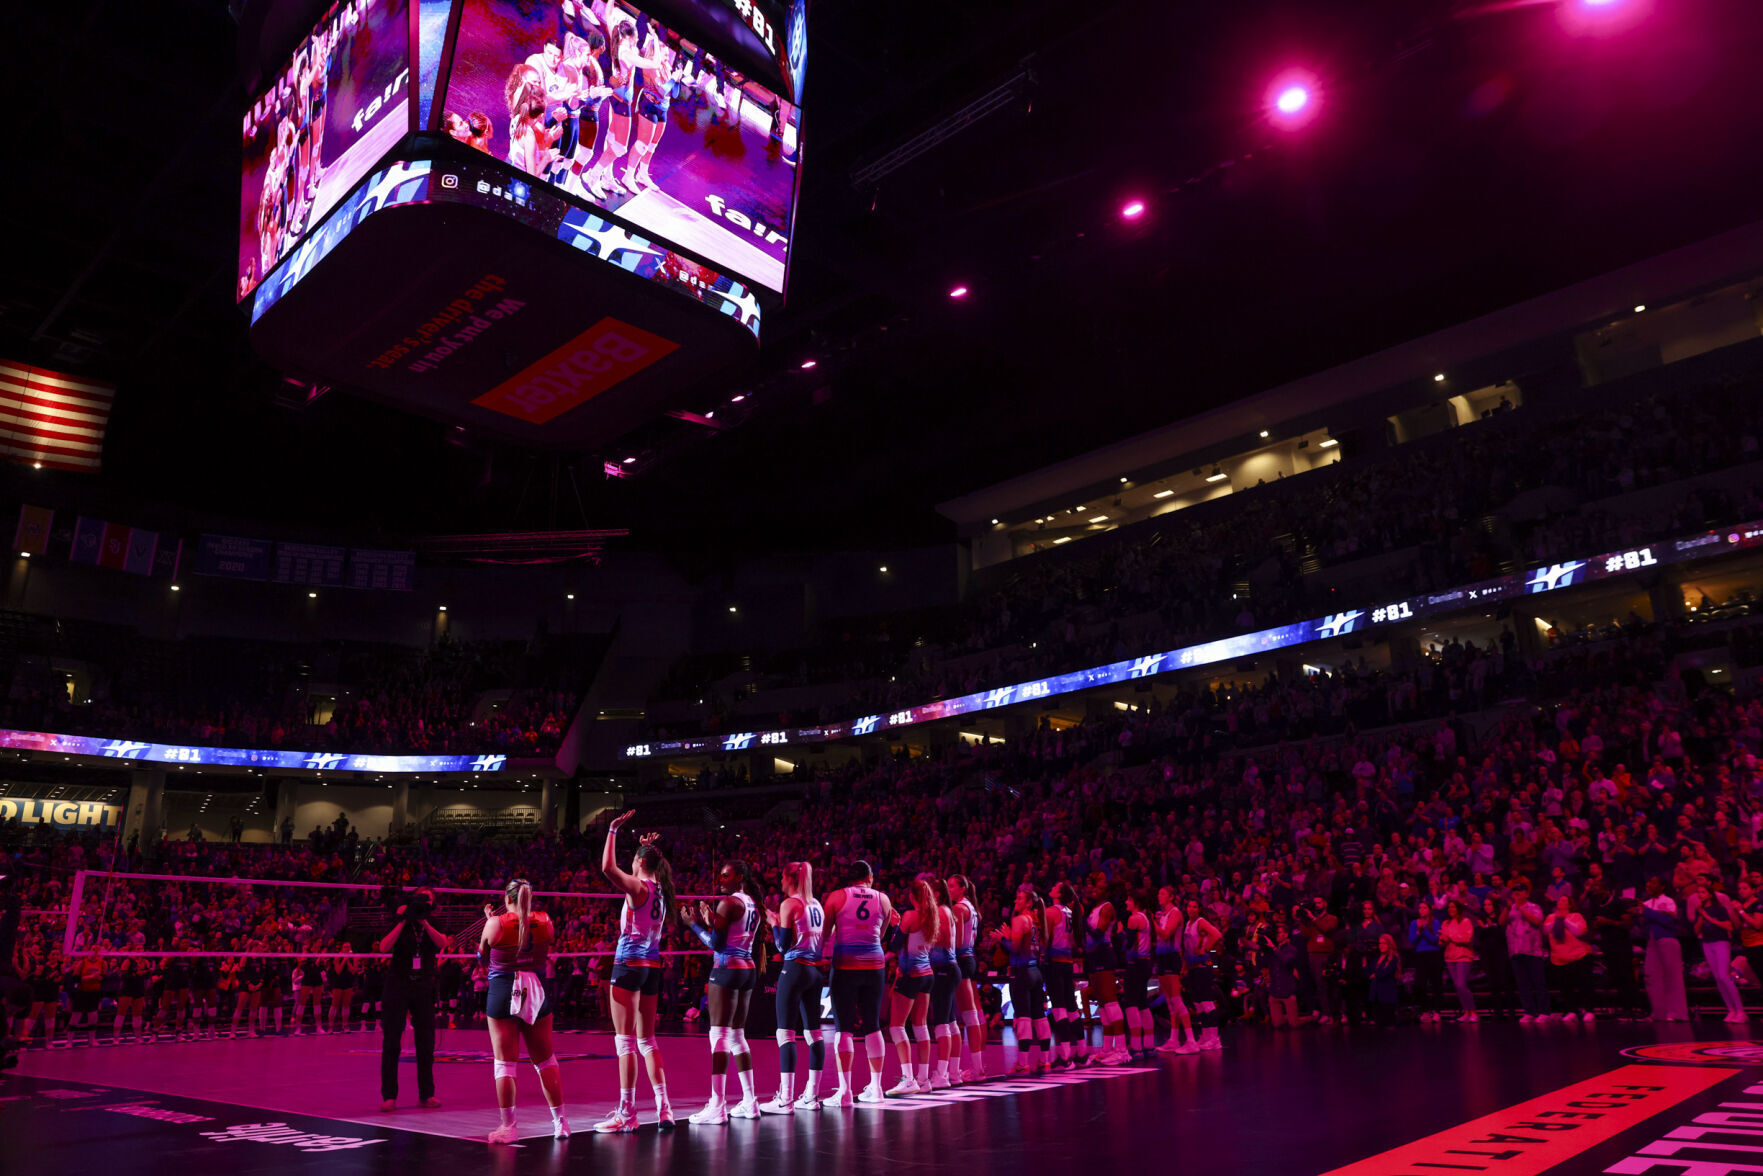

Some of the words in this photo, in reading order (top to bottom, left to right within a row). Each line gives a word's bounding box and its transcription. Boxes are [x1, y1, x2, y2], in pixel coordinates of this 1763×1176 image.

[734, 0, 776, 56] #81
[465, 273, 506, 300] the
[485, 298, 527, 319] We
[402, 298, 475, 347] driver's
[454, 315, 492, 342] put
[366, 344, 410, 369] seat.
[424, 336, 464, 362] you
[407, 360, 439, 373] in
[503, 330, 651, 414] Baxter
[1605, 548, 1657, 572] #81
[1371, 601, 1413, 623] #81
[1022, 681, 1050, 697] #81
[889, 710, 914, 725] #81
[760, 731, 788, 744] #81
[164, 748, 201, 762] #81
[626, 744, 651, 756] #81
[21, 801, 121, 826] LIGHT
[745, 910, 758, 932] 18
[808, 906, 821, 928] 10
[856, 900, 870, 921] 6
[1392, 1084, 1668, 1176] FEDERATI
